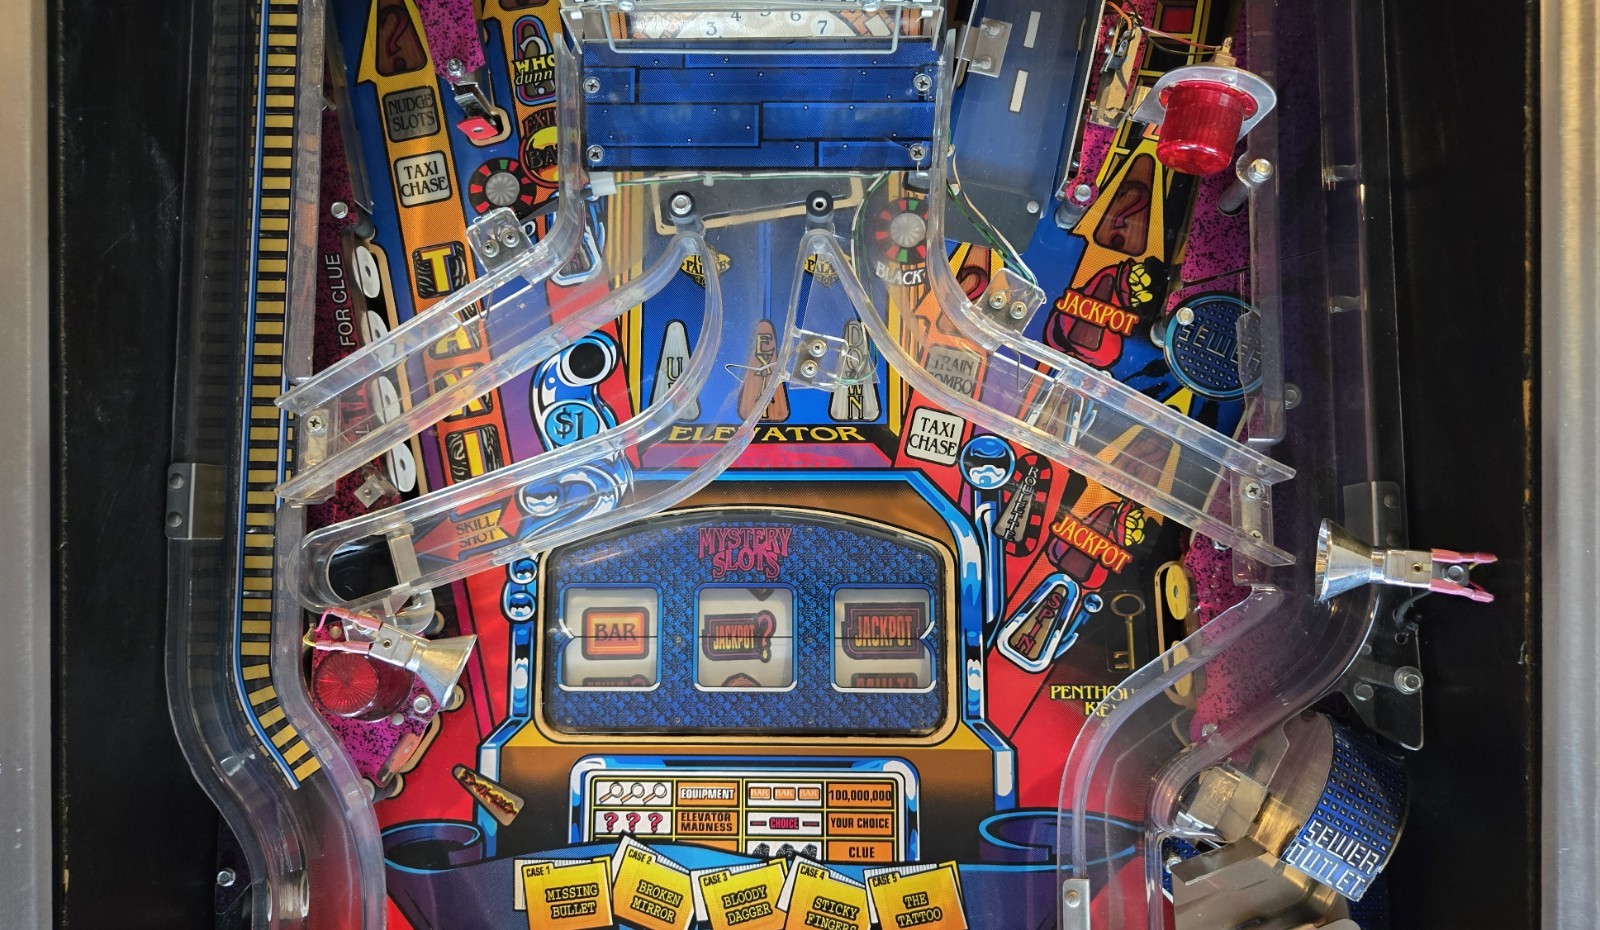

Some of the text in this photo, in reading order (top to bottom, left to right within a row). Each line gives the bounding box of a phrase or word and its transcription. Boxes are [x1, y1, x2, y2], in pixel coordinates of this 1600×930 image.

[818, 20, 828, 35] 7
[389, 94, 434, 116] NUDGE
[393, 111, 435, 132] SLOTS
[404, 160, 439, 180] TAXI
[401, 176, 449, 198] CHASE
[875, 260, 925, 286] BLACK
[325, 253, 356, 346] FOR CLUE
[1056, 292, 1137, 334] JACKPOT
[668, 426, 866, 441] ELEATOR
[921, 416, 956, 438] TAXI
[909, 433, 958, 457] CHASE
[456, 515, 496, 536] SKILL
[699, 527, 793, 559] MYSTERY
[1052, 516, 1131, 572] JACKPOT
[712, 546, 780, 579] SLOTS
[593, 623, 636, 642] BAR
[854, 616, 914, 648] JACKPOT
[1016, 593, 1062, 655] SPIN
[680, 788, 735, 800] EQUIPMENT
[828, 790, 892, 802] 100,000,000
[681, 812, 731, 823] ELEVATOR
[681, 823, 733, 832] MADNESS
[770, 817, 799, 829] CHOICE
[831, 817, 890, 829] YOUR CHOICE
[627, 848, 645, 861] CASE
[848, 846, 875, 859] CLUE
[1303, 819, 1380, 875] SEWER
[526, 866, 544, 878] CASE
[801, 865, 818, 878] CASE
[1285, 842, 1366, 896] OUTLET
[638, 879, 681, 904] BROKEN
[703, 876, 721, 887] CASE
[872, 876, 892, 887] CASE
[546, 884, 599, 901] MISSING
[723, 886, 767, 908] BLOODY
[905, 893, 928, 908] THE
[551, 901, 597, 917] BULLET
[632, 898, 675, 922] MIRROR
[728, 905, 772, 925] DAGGER
[814, 896, 858, 920] STICKY
[897, 908, 941, 927] TATTOO
